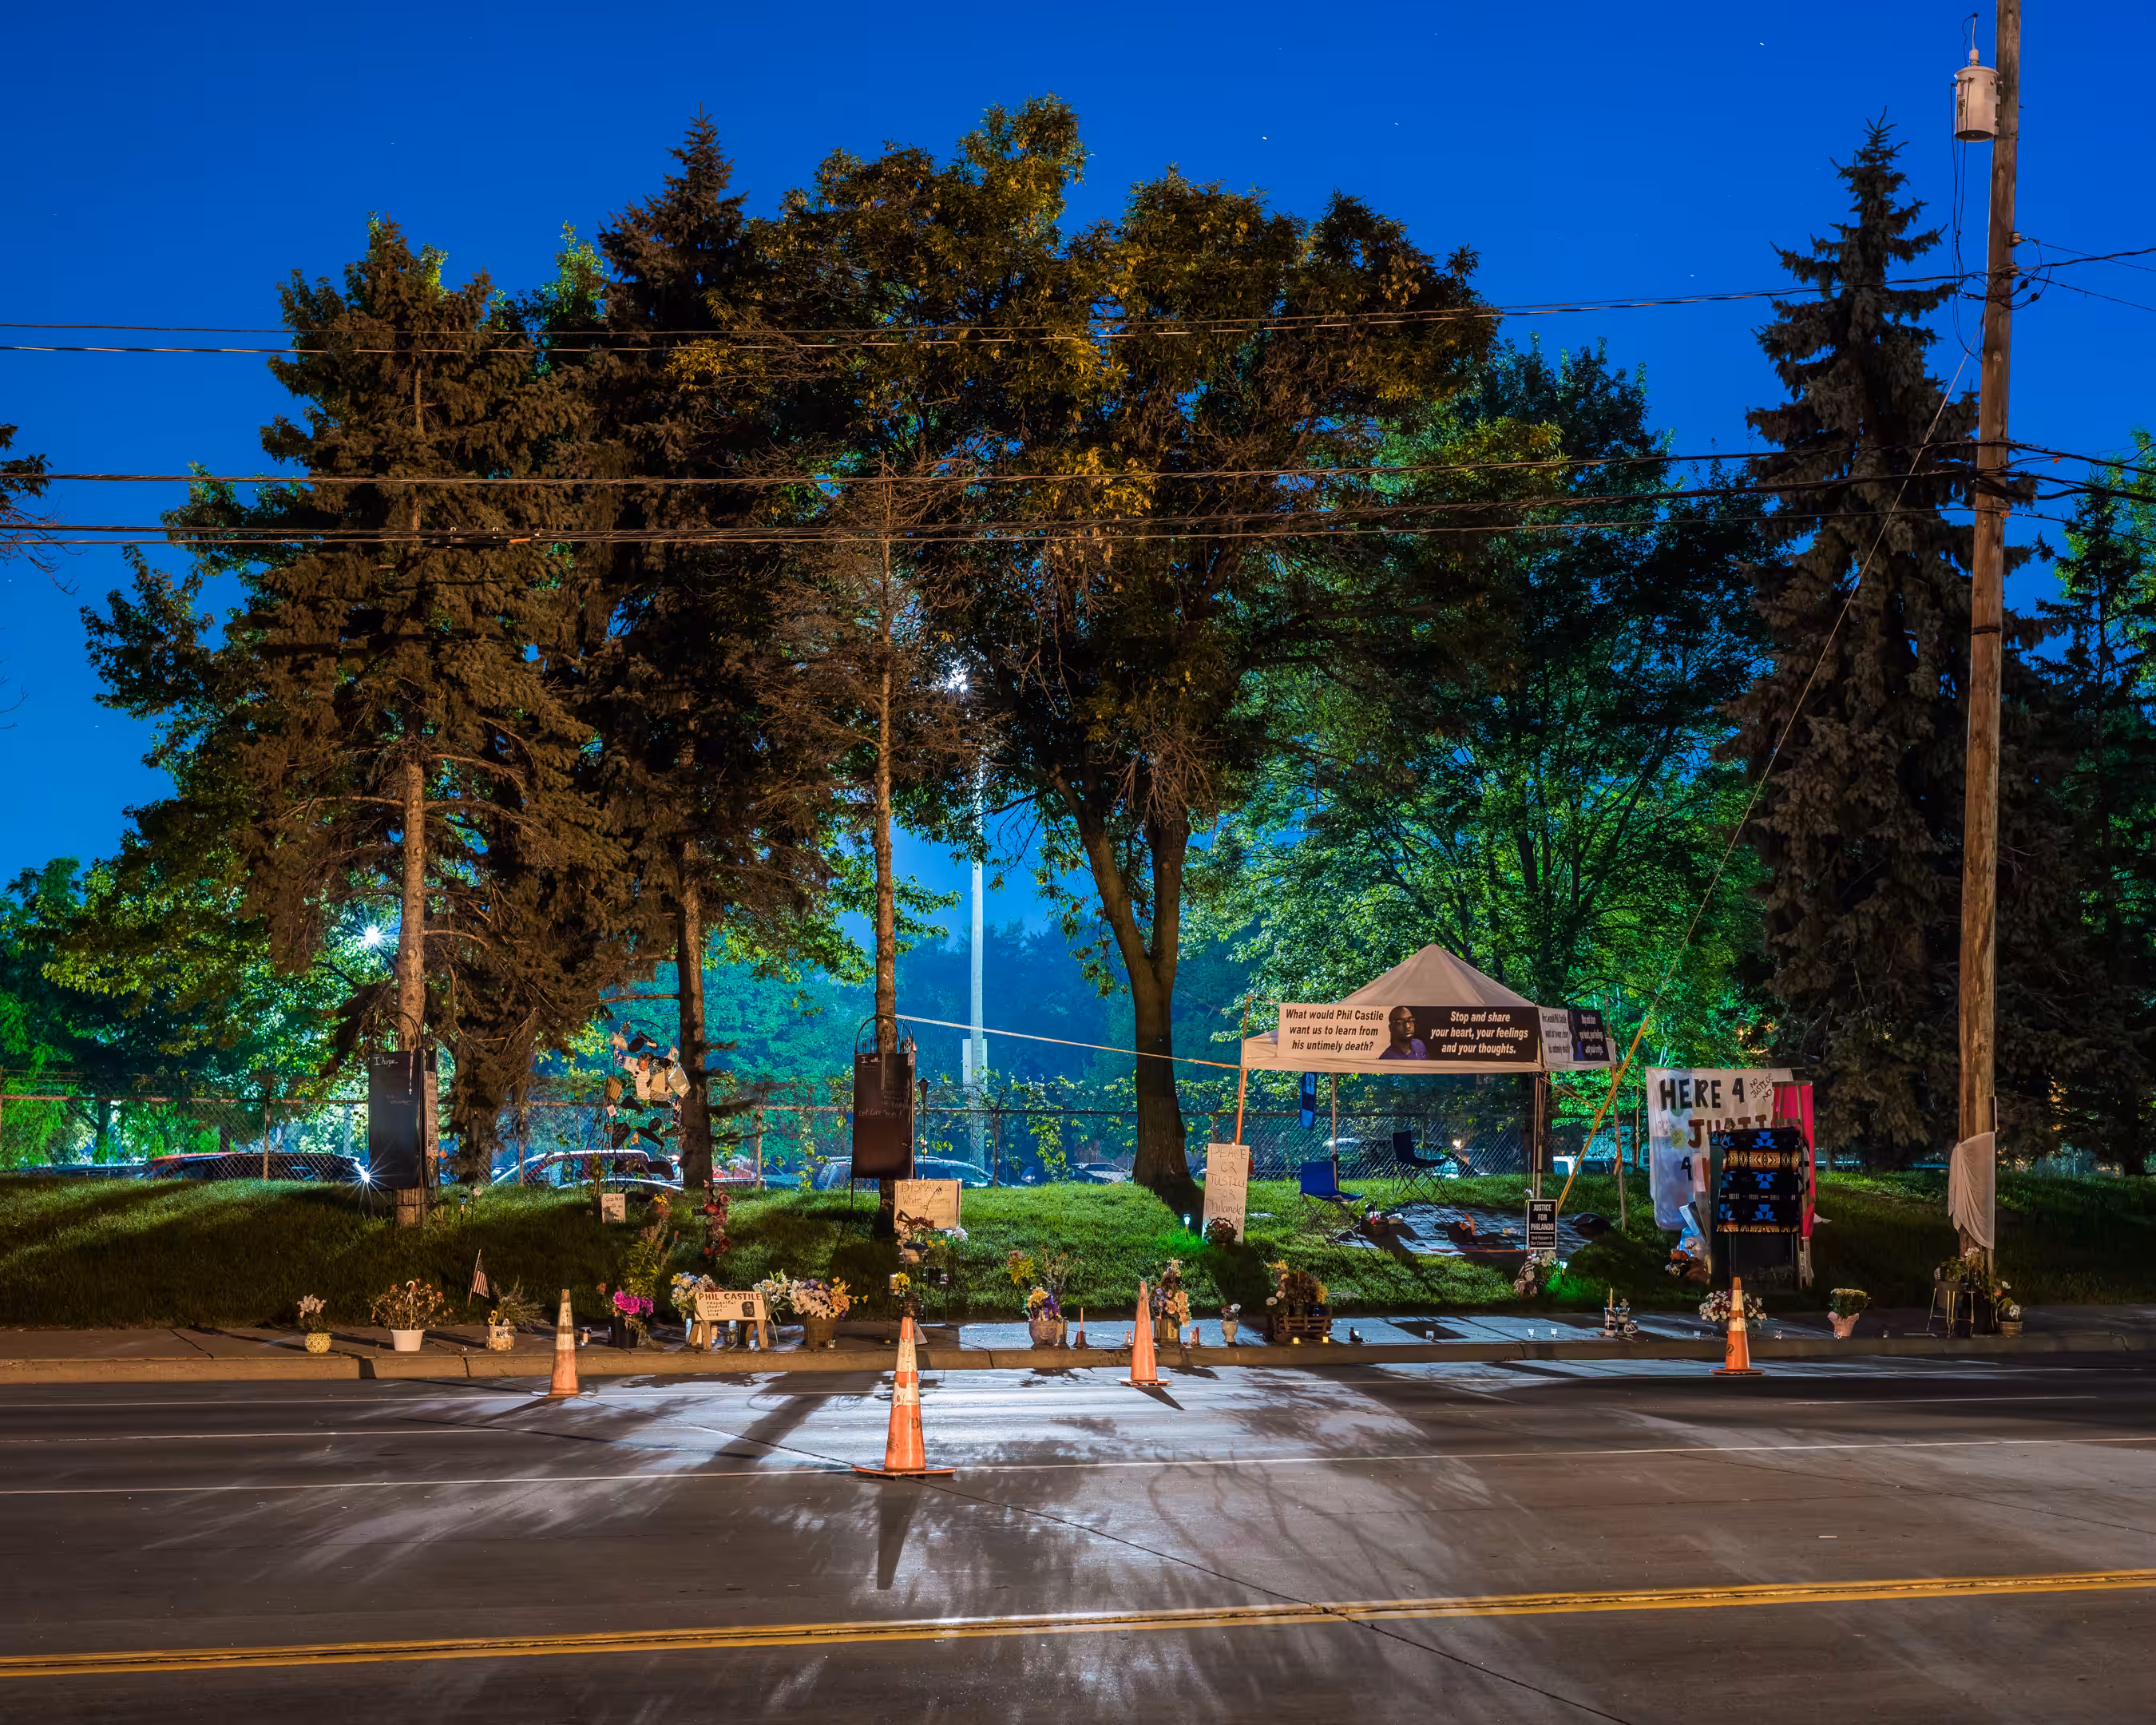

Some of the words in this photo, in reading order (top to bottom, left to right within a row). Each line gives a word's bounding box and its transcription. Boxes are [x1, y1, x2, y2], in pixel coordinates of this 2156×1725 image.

[1286, 1009, 1307, 1019] What
[1309, 1009, 1334, 1020] would
[1336, 1009, 1353, 1020] Phil
[1354, 1009, 1384, 1021] Castile
[1450, 1010, 1469, 1025] Stop
[1470, 1011, 1487, 1022] and
[1488, 1011, 1511, 1022] share
[1290, 1025, 1310, 1035] want
[1324, 1025, 1334, 1035] to
[1335, 1025, 1357, 1036] learn
[1358, 1025, 1378, 1036] from
[1430, 1029, 1449, 1040] your
[1450, 1026, 1475, 1039] heart,
[1476, 1029, 1496, 1041] your
[1496, 1026, 1529, 1041] feelings
[1291, 1040, 1305, 1050] his
[1306, 1040, 1344, 1053] untimely
[1345, 1041, 1373, 1051] death?
[1441, 1042, 1458, 1053] and
[1458, 1044, 1477, 1056] your
[1478, 1042, 1516, 1056] thoughts.
[1750, 1078, 1759, 1089] NO
[1660, 1078, 1722, 1111] HERE
[1732, 1078, 1745, 1104] 4
[1211, 1145, 1246, 1162] PEACE
